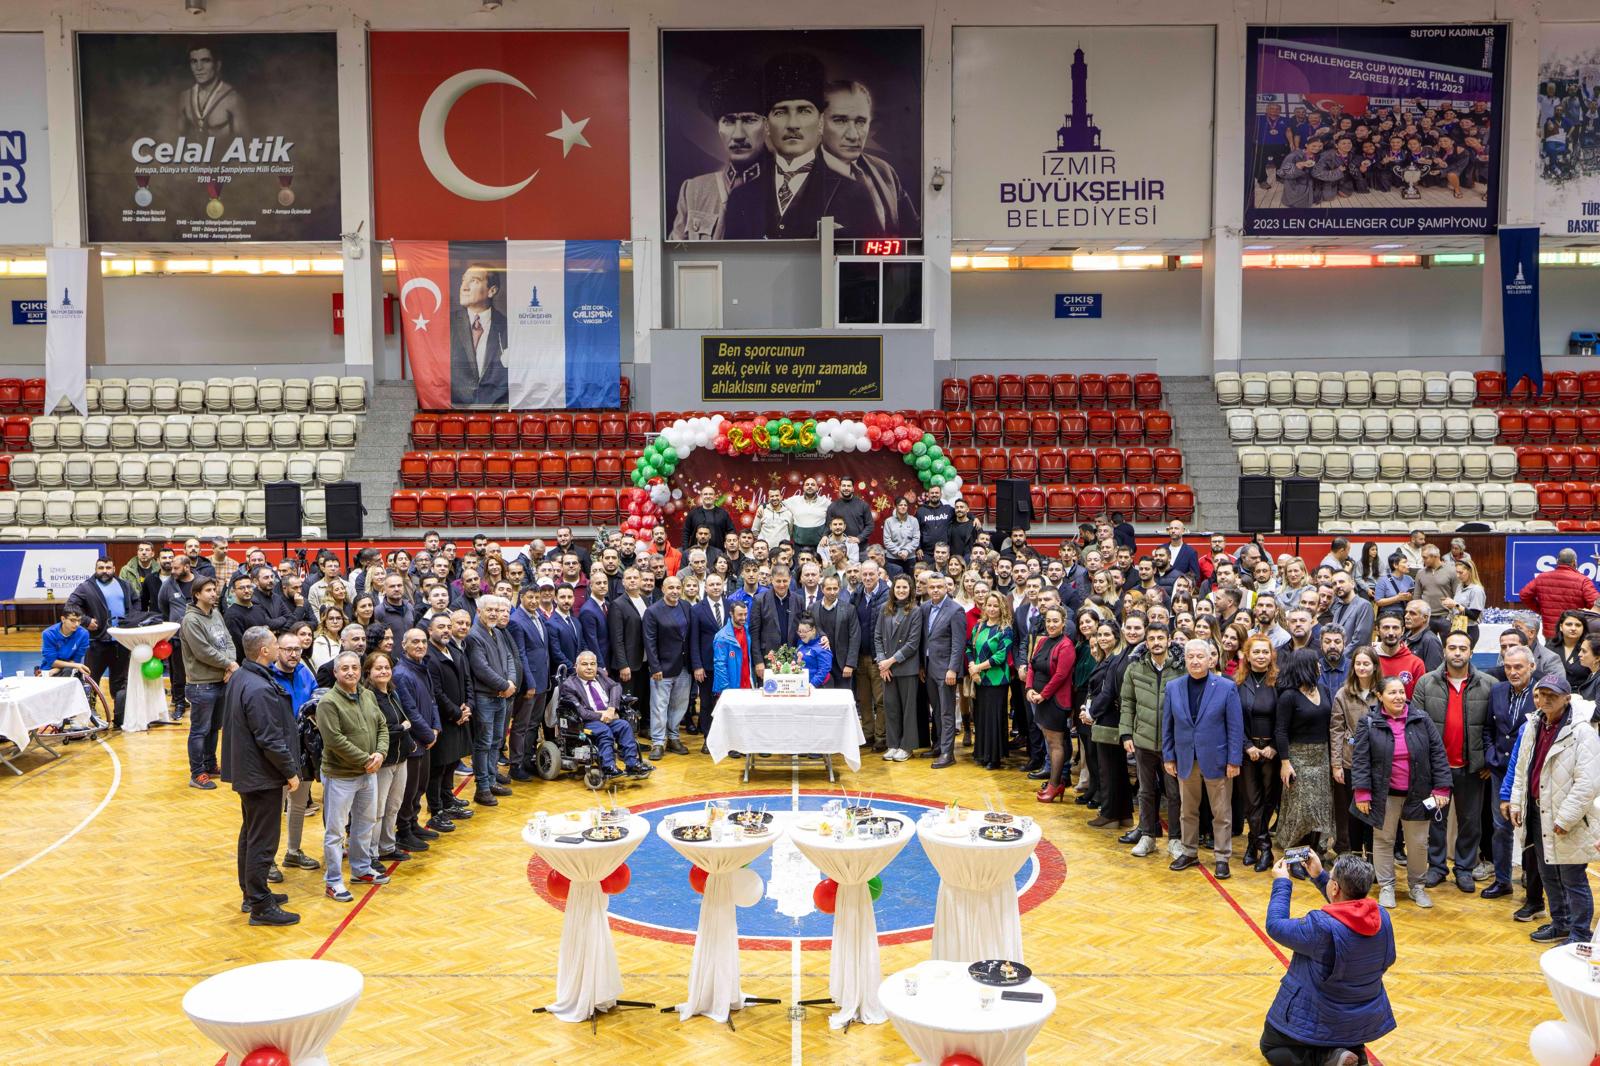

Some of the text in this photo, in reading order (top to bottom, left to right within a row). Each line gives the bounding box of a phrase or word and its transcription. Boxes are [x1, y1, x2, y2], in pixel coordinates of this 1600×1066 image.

[1410, 28, 1494, 38] SUTOPU KADINLAR
[1278, 49, 1465, 84] LEN CHALLENGER CUP WOMEN FINAL 6
[1349, 71, 1389, 84] ZAGREB
[1398, 78, 1409, 87] 24
[1416, 80, 1463, 94] 26.11.2023
[131, 136, 294, 164] Celal Atik
[159, 166, 180, 174] Dünya
[189, 166, 220, 174] Olimpiyat
[220, 166, 255, 174] Şampiyonu
[1042, 154, 1116, 176] İZMİR
[217, 175, 232, 183] 1979
[1000, 177, 1165, 204] BÜYÜKŞEHİR
[1007, 203, 1157, 228] BELEDİYESİ
[1253, 215, 1487, 230] 2023 LEN CHALLENGER CUP ŞAMPİYONU
[866, 240, 900, 255] 14:37
[1063, 295, 1094, 305] ÇIKIŞ
[718, 342, 805, 359] Ben sporcunun
[711, 361, 868, 378] zeki, çevik ve aynı zamanda
[711, 379, 822, 394] ahlaklısını severim"
[727, 421, 815, 452] 2026
